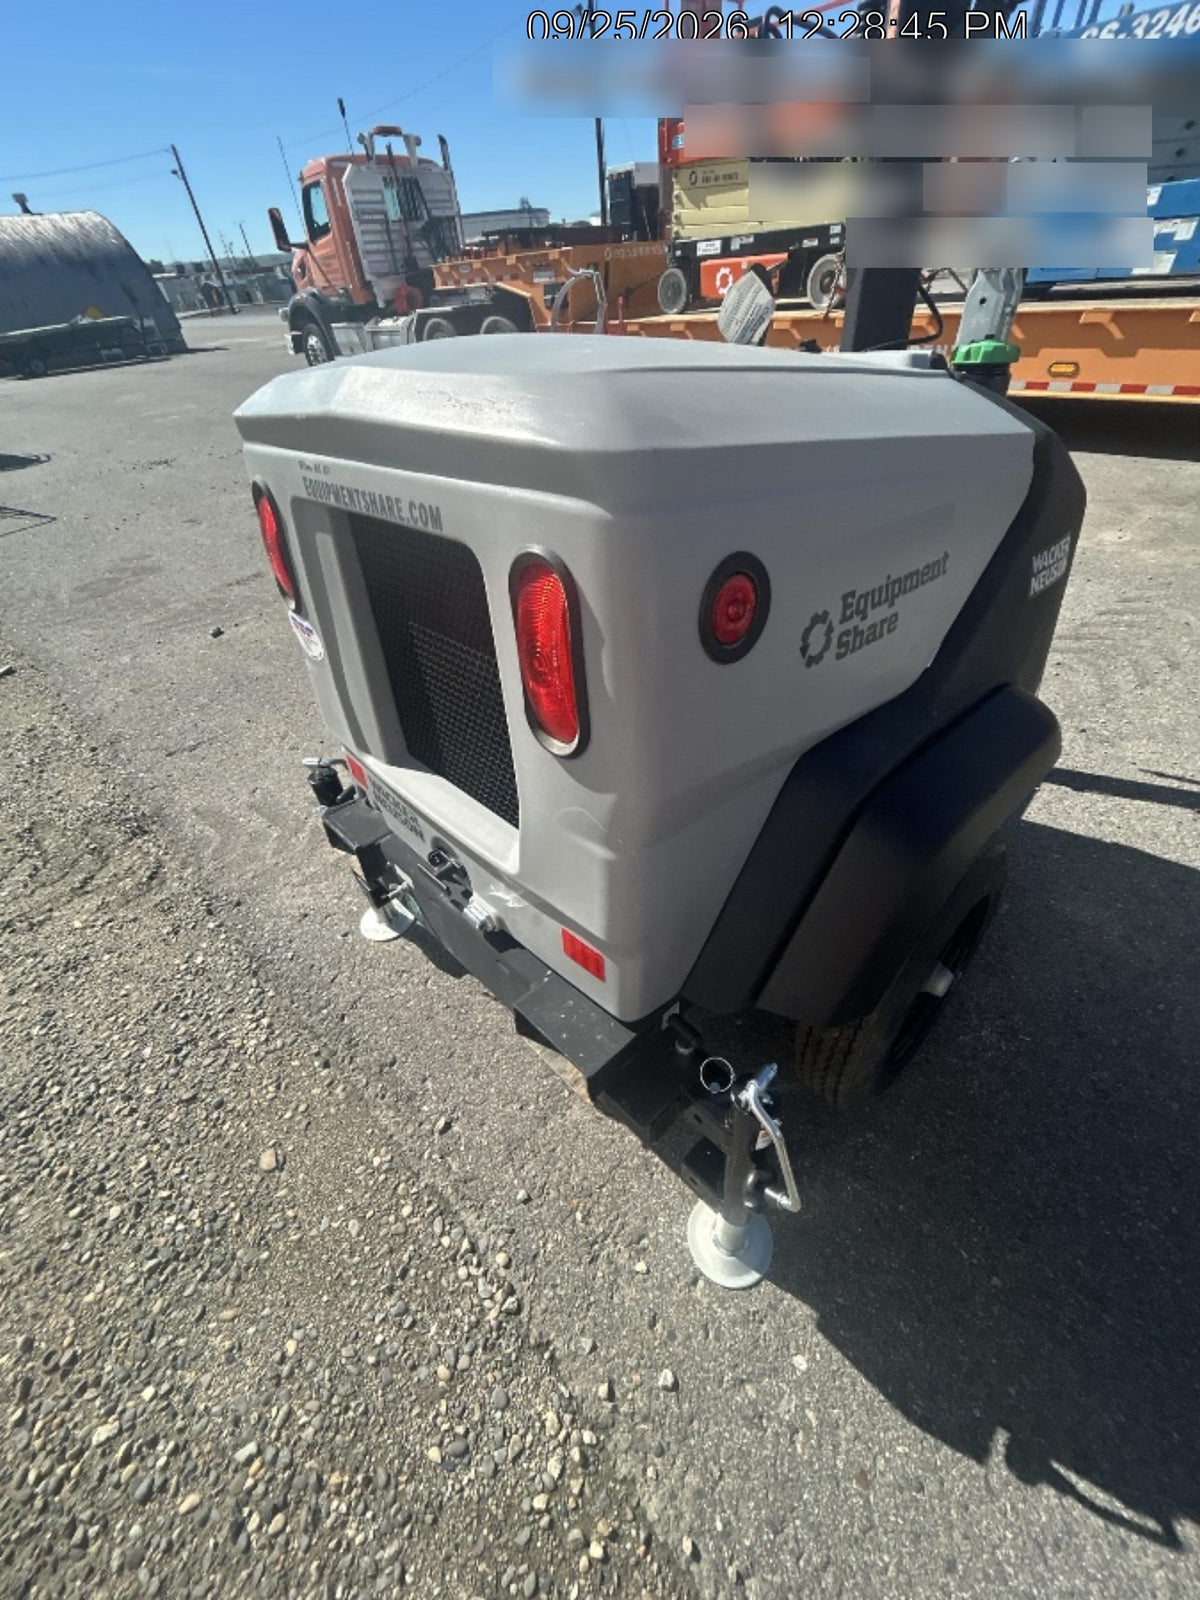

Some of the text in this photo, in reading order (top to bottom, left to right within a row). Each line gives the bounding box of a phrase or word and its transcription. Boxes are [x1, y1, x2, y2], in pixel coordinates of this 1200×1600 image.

[302, 476, 444, 533] EQUIPMENTSHARE.COM
[839, 550, 950, 625] Equipment
[835, 612, 899, 661] Share
